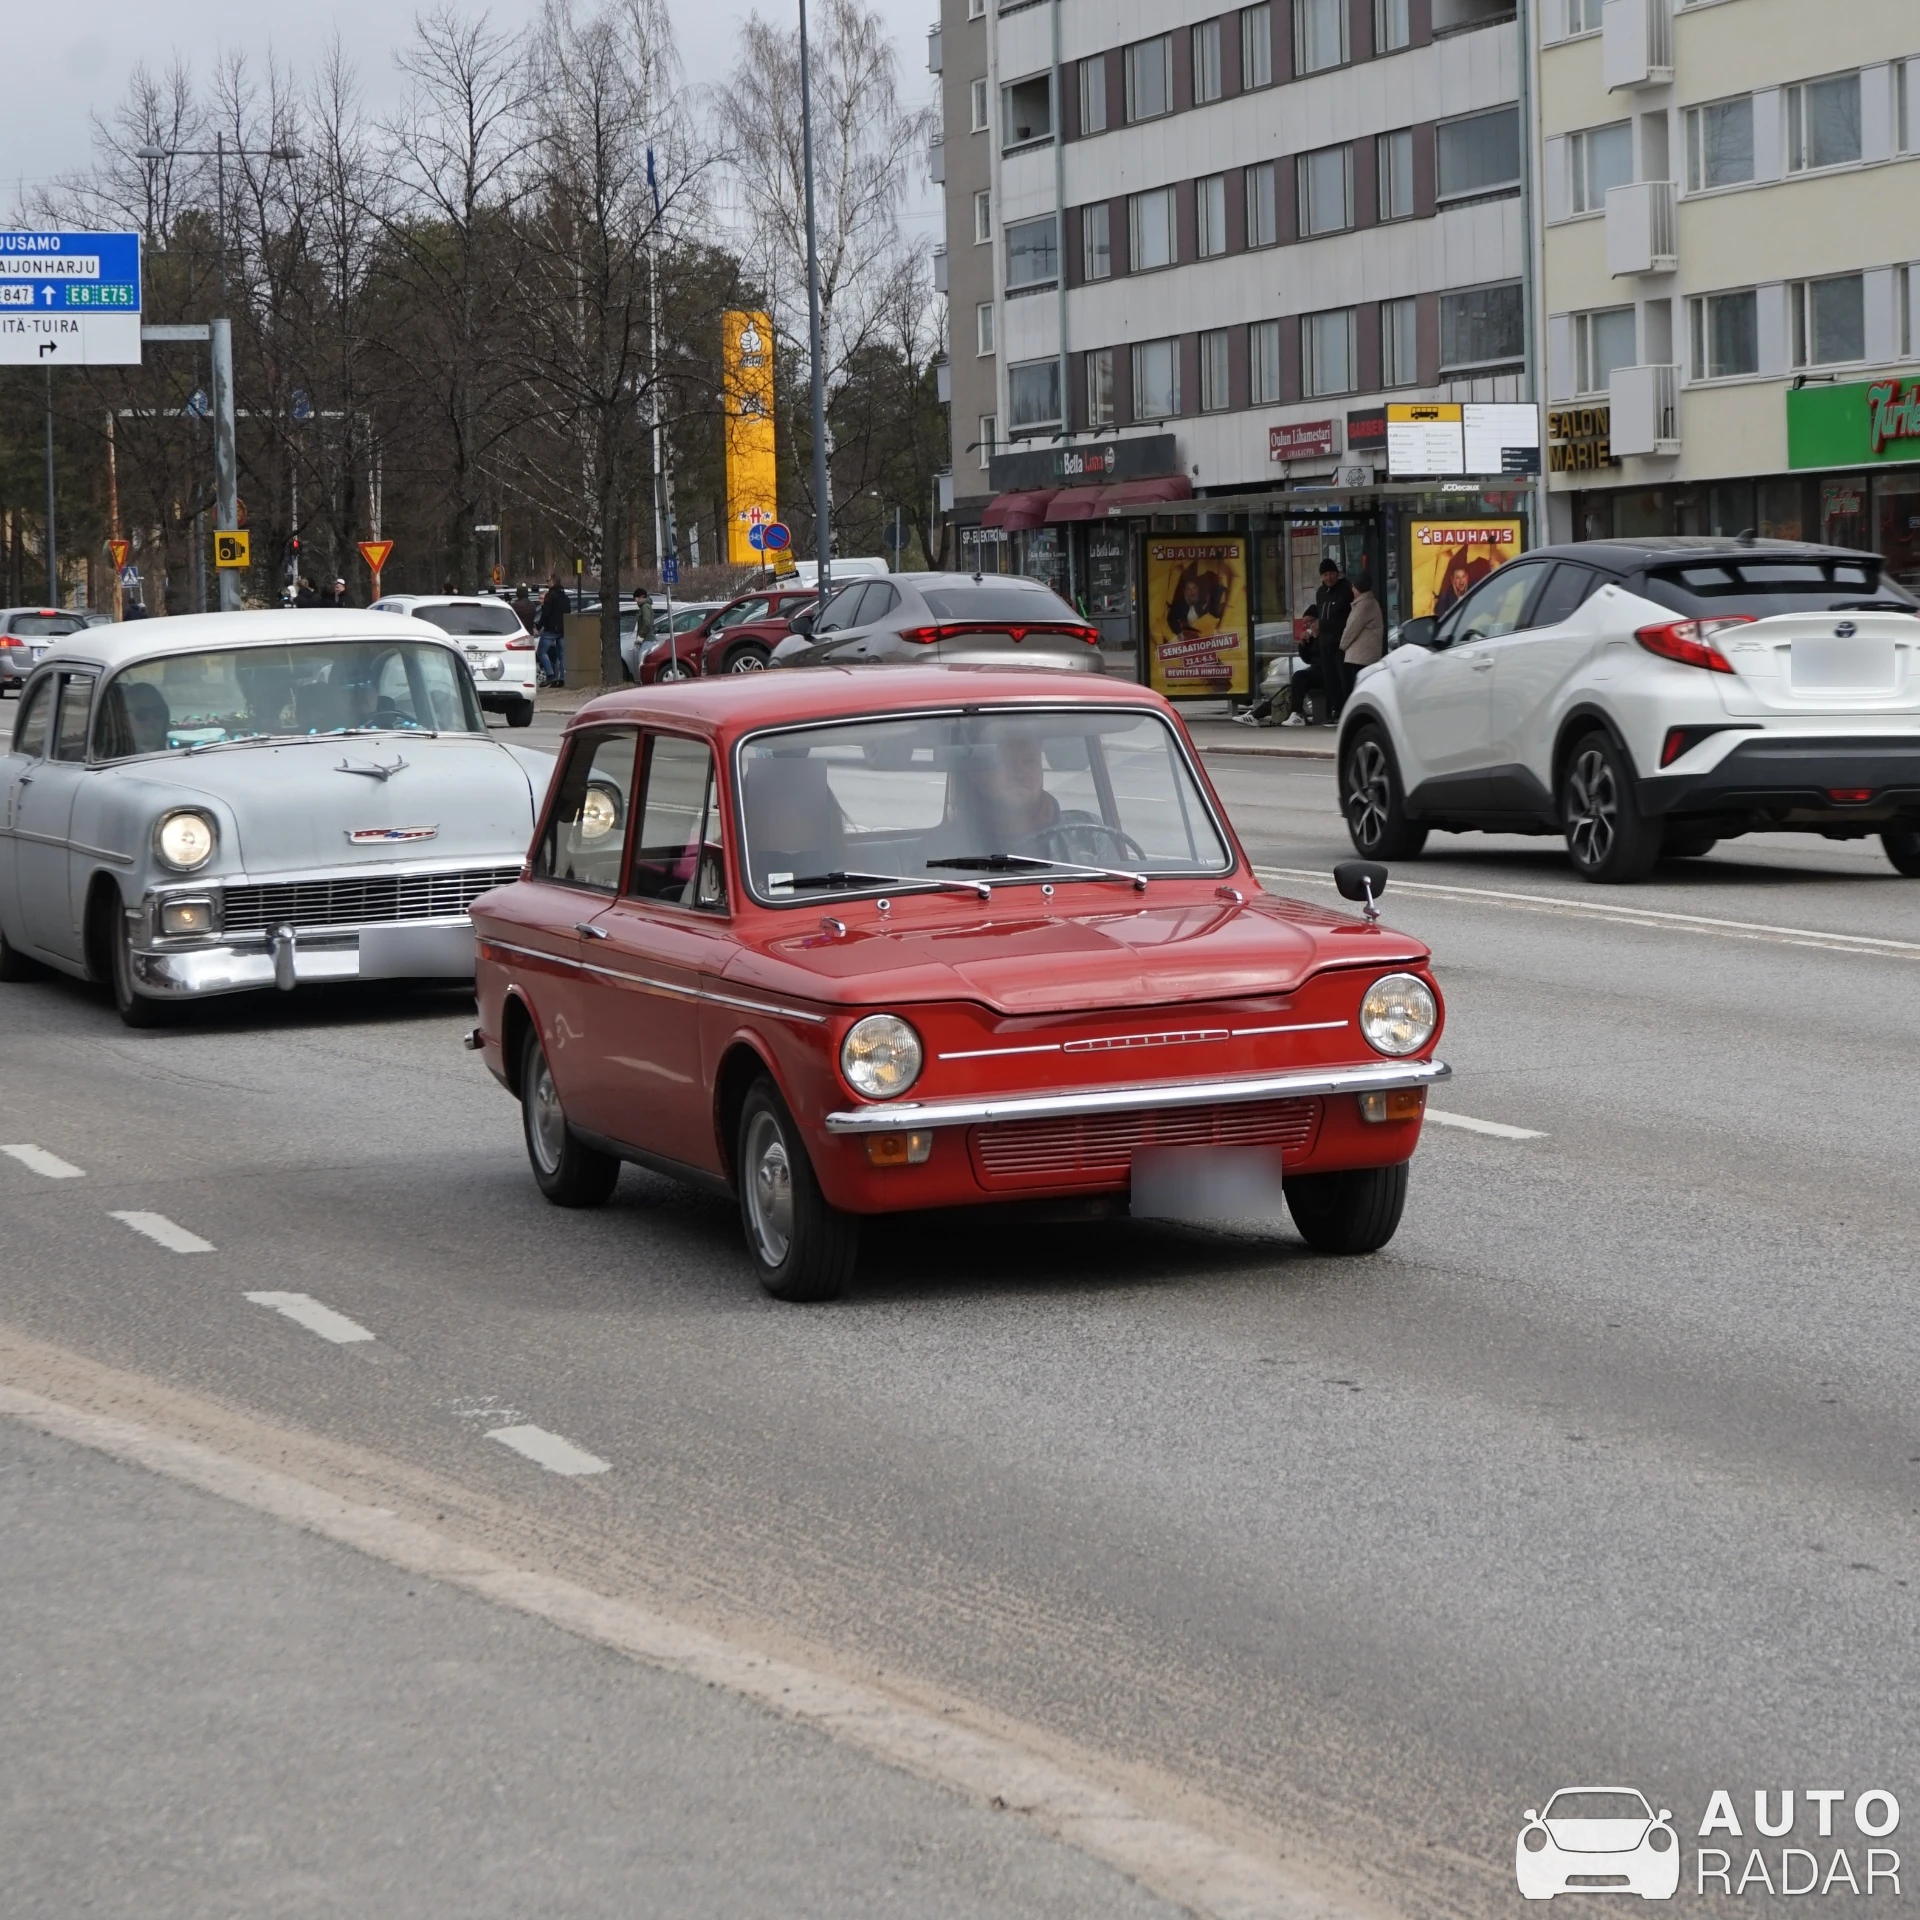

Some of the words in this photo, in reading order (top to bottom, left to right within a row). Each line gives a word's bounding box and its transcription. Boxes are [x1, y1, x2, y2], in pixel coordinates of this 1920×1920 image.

[4, 288, 29, 302] 847
[71, 288, 90, 302] E8
[101, 288, 128, 302] E75
[3, 317, 79, 333] ITÄ-TUIRA
[1348, 418, 1385, 439] BARBER
[1548, 407, 1608, 439] SALON
[1270, 432, 1292, 447] Oulun
[1292, 425, 1331, 445] Lihamestari
[1064, 453, 1083, 475] Bella
[1084, 448, 1103, 472] Luna
[1548, 441, 1609, 472] MARIE
[1441, 484, 1480, 492] JCDecaux
[1433, 529, 1512, 543] BAUHAUS
[1162, 636, 1233, 657] SENSAATIOPÄIVÄT
